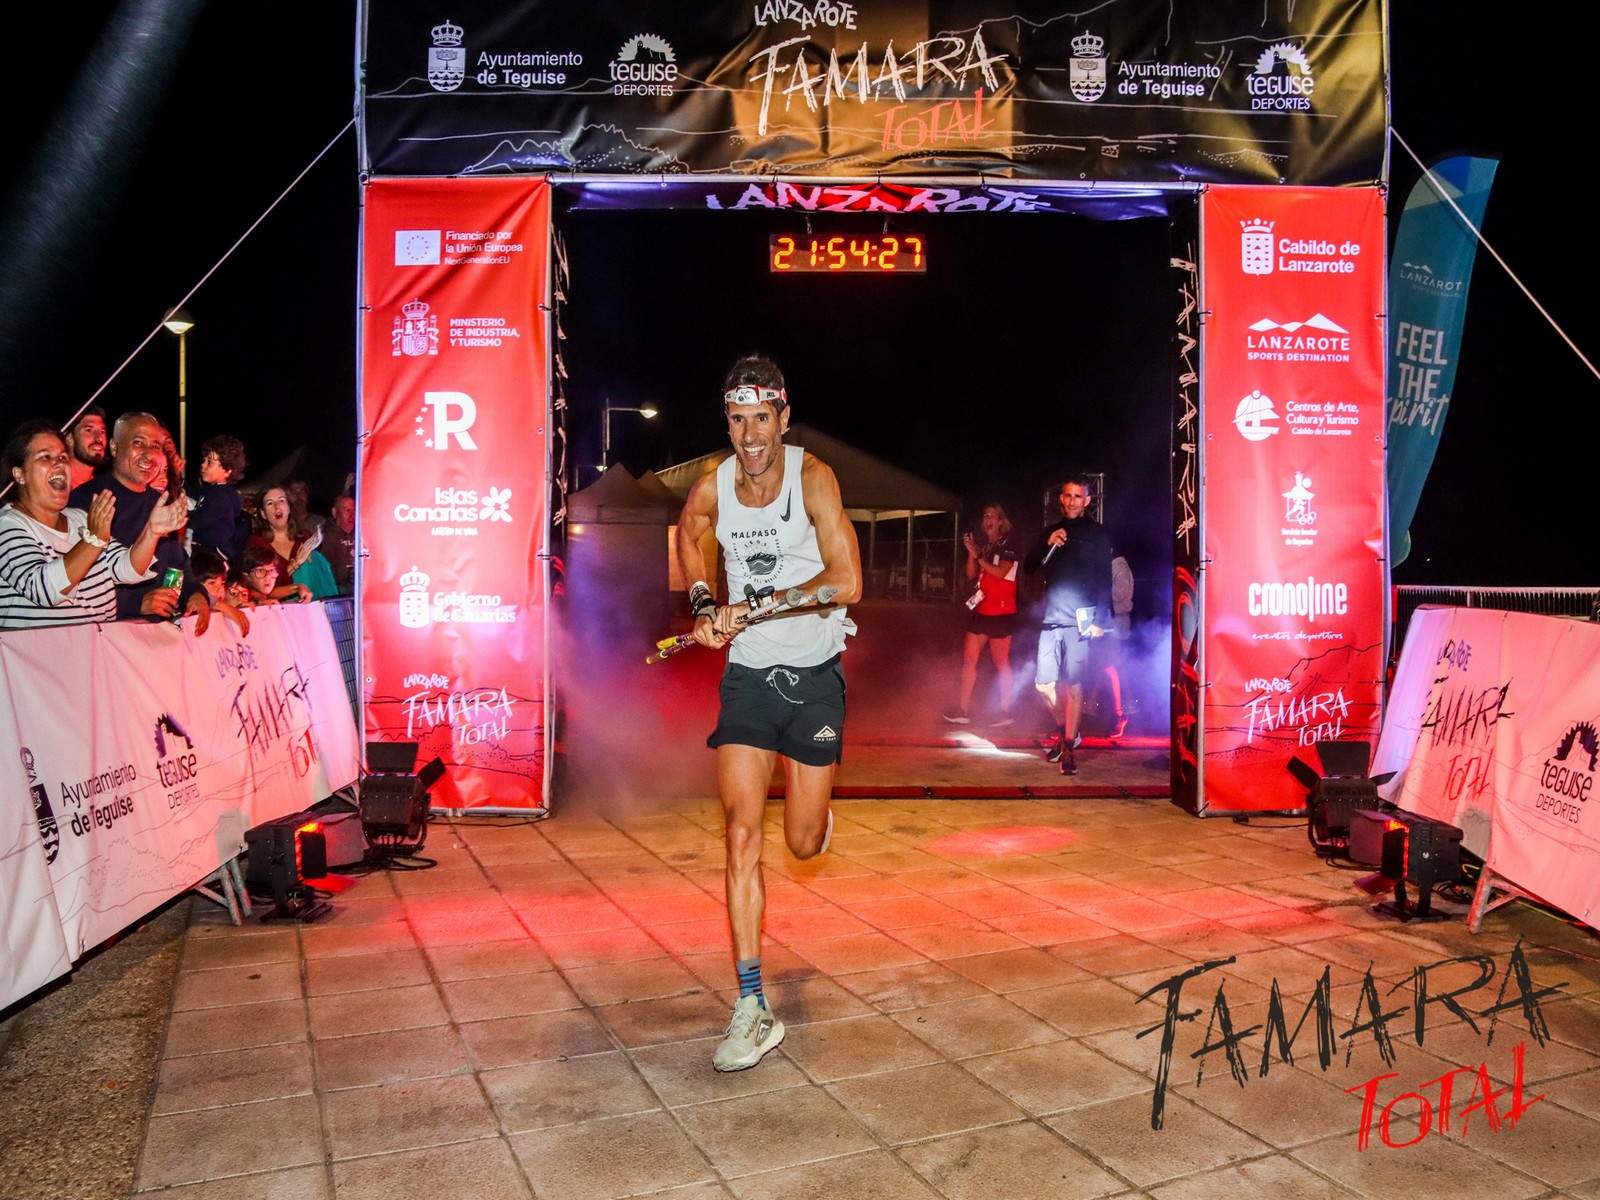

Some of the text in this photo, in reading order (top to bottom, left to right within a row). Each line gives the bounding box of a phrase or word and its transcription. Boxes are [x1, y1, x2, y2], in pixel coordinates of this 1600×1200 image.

[754, 0, 857, 31] LANZAROTE
[477, 50, 583, 68] Ayuntamiento
[1118, 60, 1221, 79] Ayuntamiento
[477, 70, 566, 88] de Teguise
[749, 25, 1009, 137] FAMARA
[614, 84, 673, 97] DEPORTES
[1118, 80, 1205, 98] de Teguise
[1251, 98, 1310, 110] DEPORTES
[875, 87, 995, 152] TOTAL
[446, 230, 513, 242] Financiado por
[445, 243, 455, 253] la
[484, 242, 523, 254] Europea
[774, 237, 921, 269] 21:54:27
[1279, 239, 1360, 256] Cabildo de
[1279, 256, 1354, 274] Lanzarote
[450, 318, 505, 327] MINISTERIO
[450, 328, 520, 338] DE INDUSTRIA,
[450, 338, 501, 347] Y TURISMO
[1247, 335, 1350, 351] LANZAROTE
[1395, 321, 1448, 365] FEEL
[1247, 352, 1349, 363] SPORTS DESTINATION
[1398, 362, 1441, 403] THE
[1286, 400, 1321, 412] Centros
[1323, 401, 1336, 412] de
[1386, 394, 1449, 436] pirit
[424, 391, 478, 450] R
[1286, 413, 1359, 427] Cultura y Turismo
[435, 487, 478, 507] Islas
[394, 503, 478, 522] Canarias
[731, 528, 777, 539] MALPASO
[433, 592, 501, 607] Gobierno
[403, 673, 449, 690] LANZAROTE
[1245, 677, 1293, 693] LANZAROTE
[402, 686, 517, 738] FAMARA
[1243, 686, 1354, 744] FAMARA
[458, 716, 512, 746] TOTAL
[1296, 716, 1345, 747] TOTAL
[71, 796, 134, 837] de Teguise
[1535, 793, 1581, 824] DEPORTES
